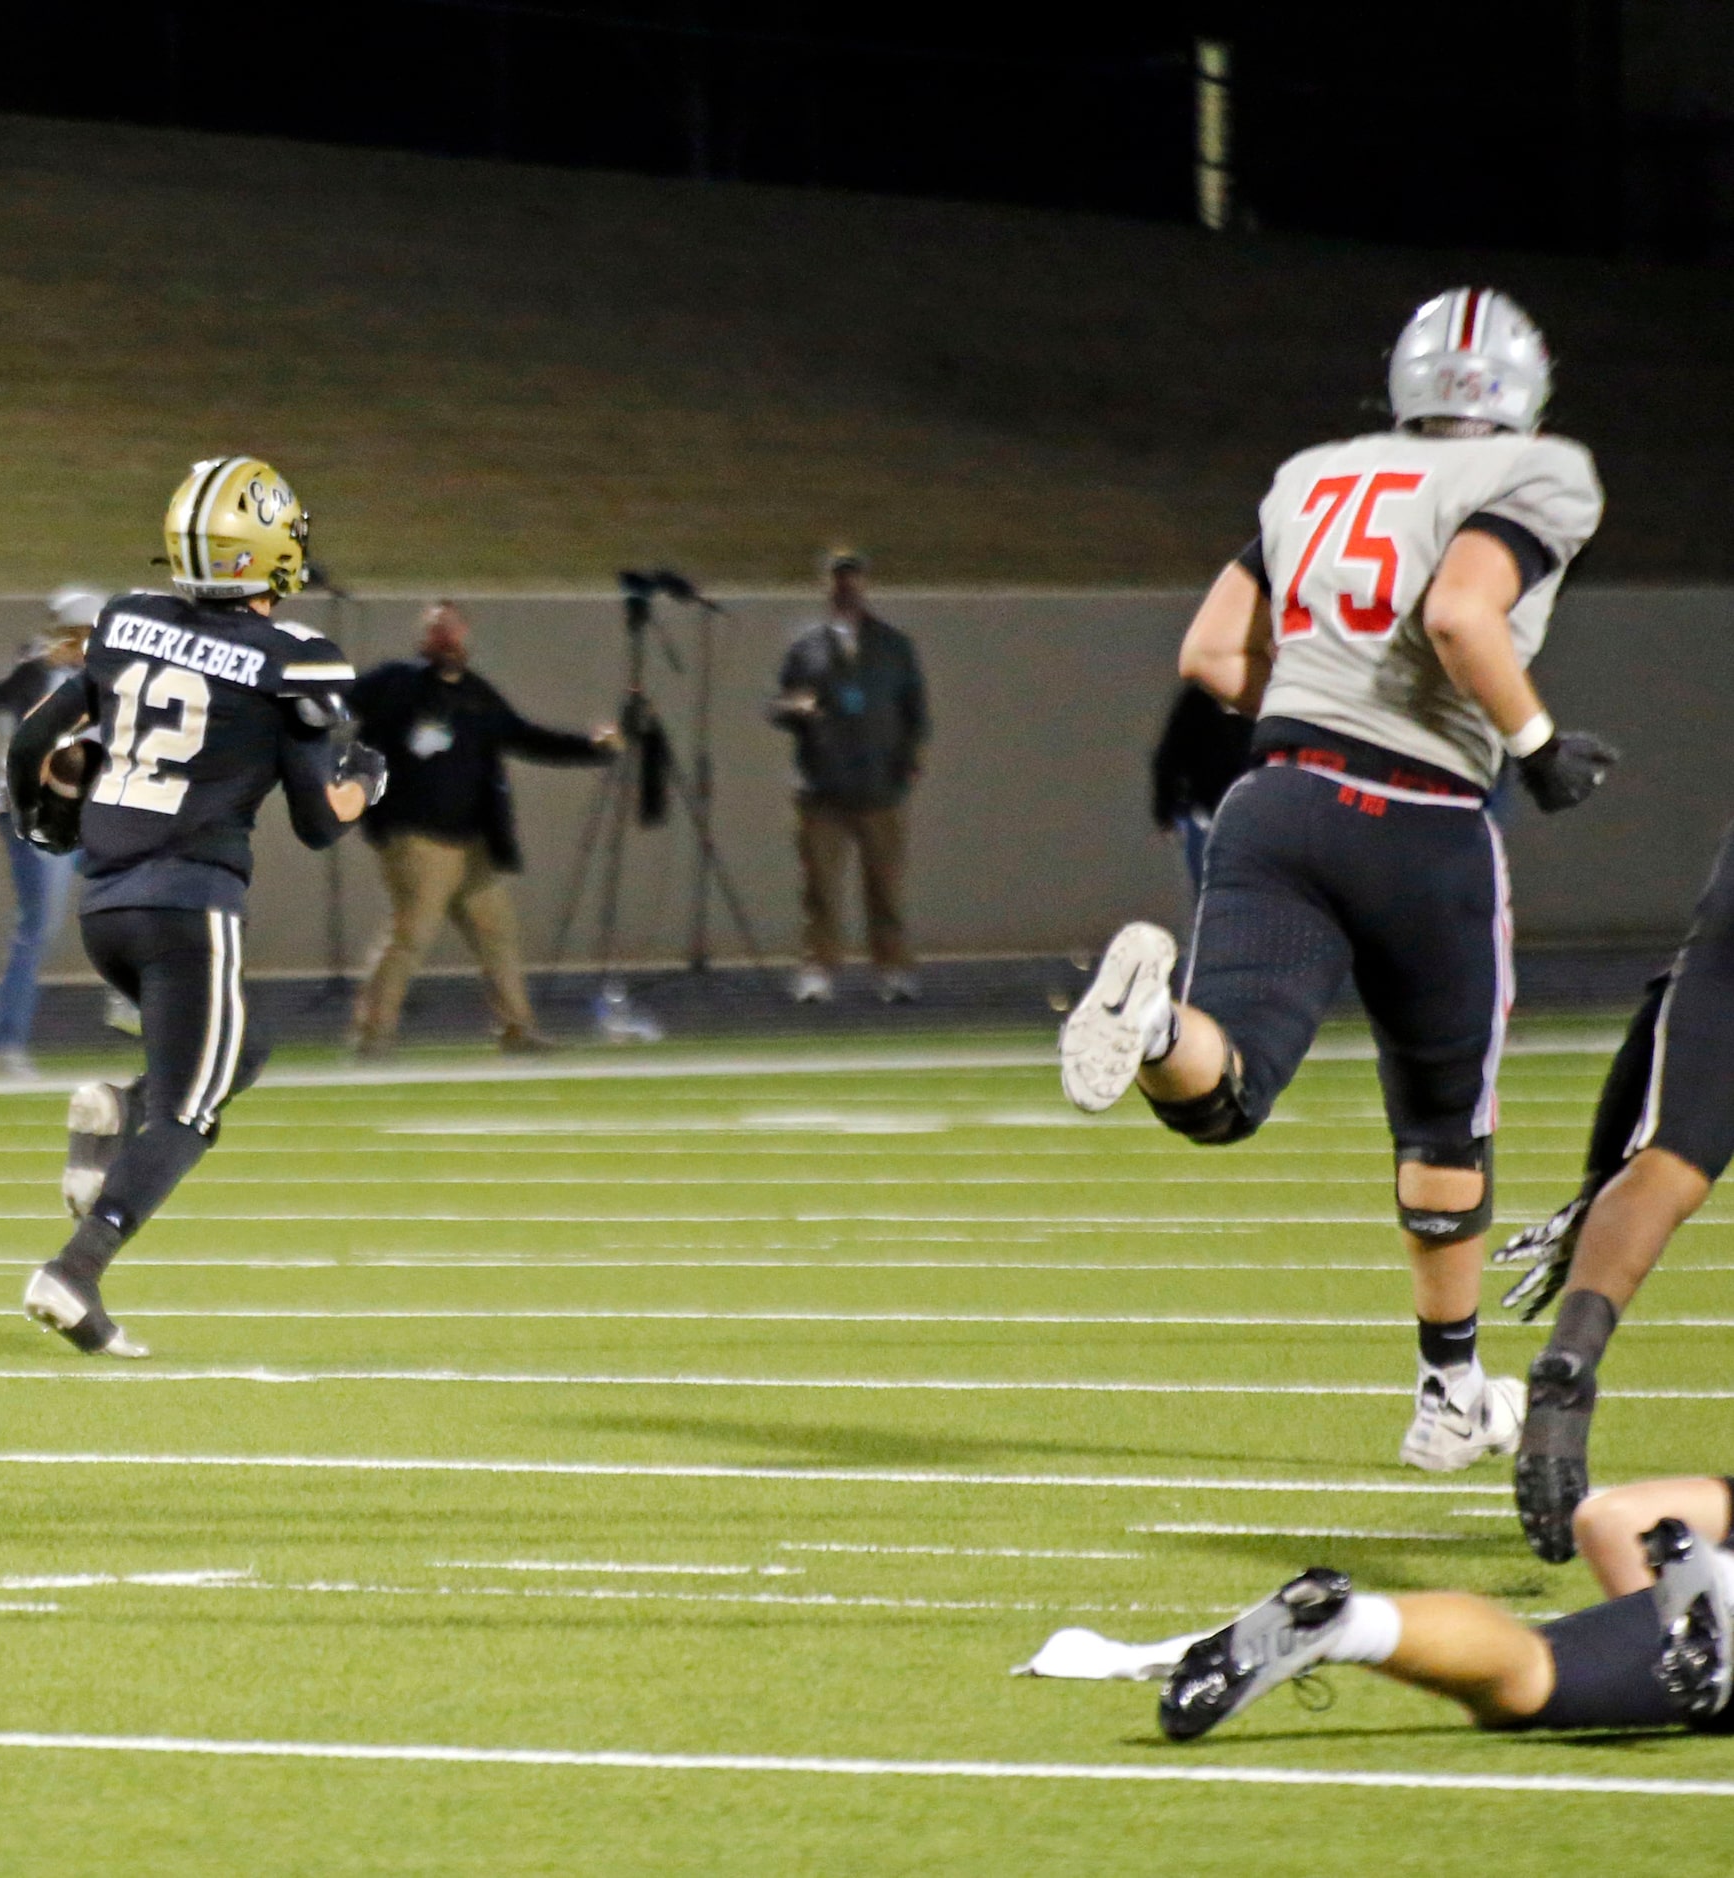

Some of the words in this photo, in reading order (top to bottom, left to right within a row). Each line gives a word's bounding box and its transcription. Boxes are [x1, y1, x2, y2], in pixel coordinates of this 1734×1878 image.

[1277, 469, 1428, 642] 75
[105, 614, 267, 688] KEIERLEBER
[91, 661, 211, 816] 12
